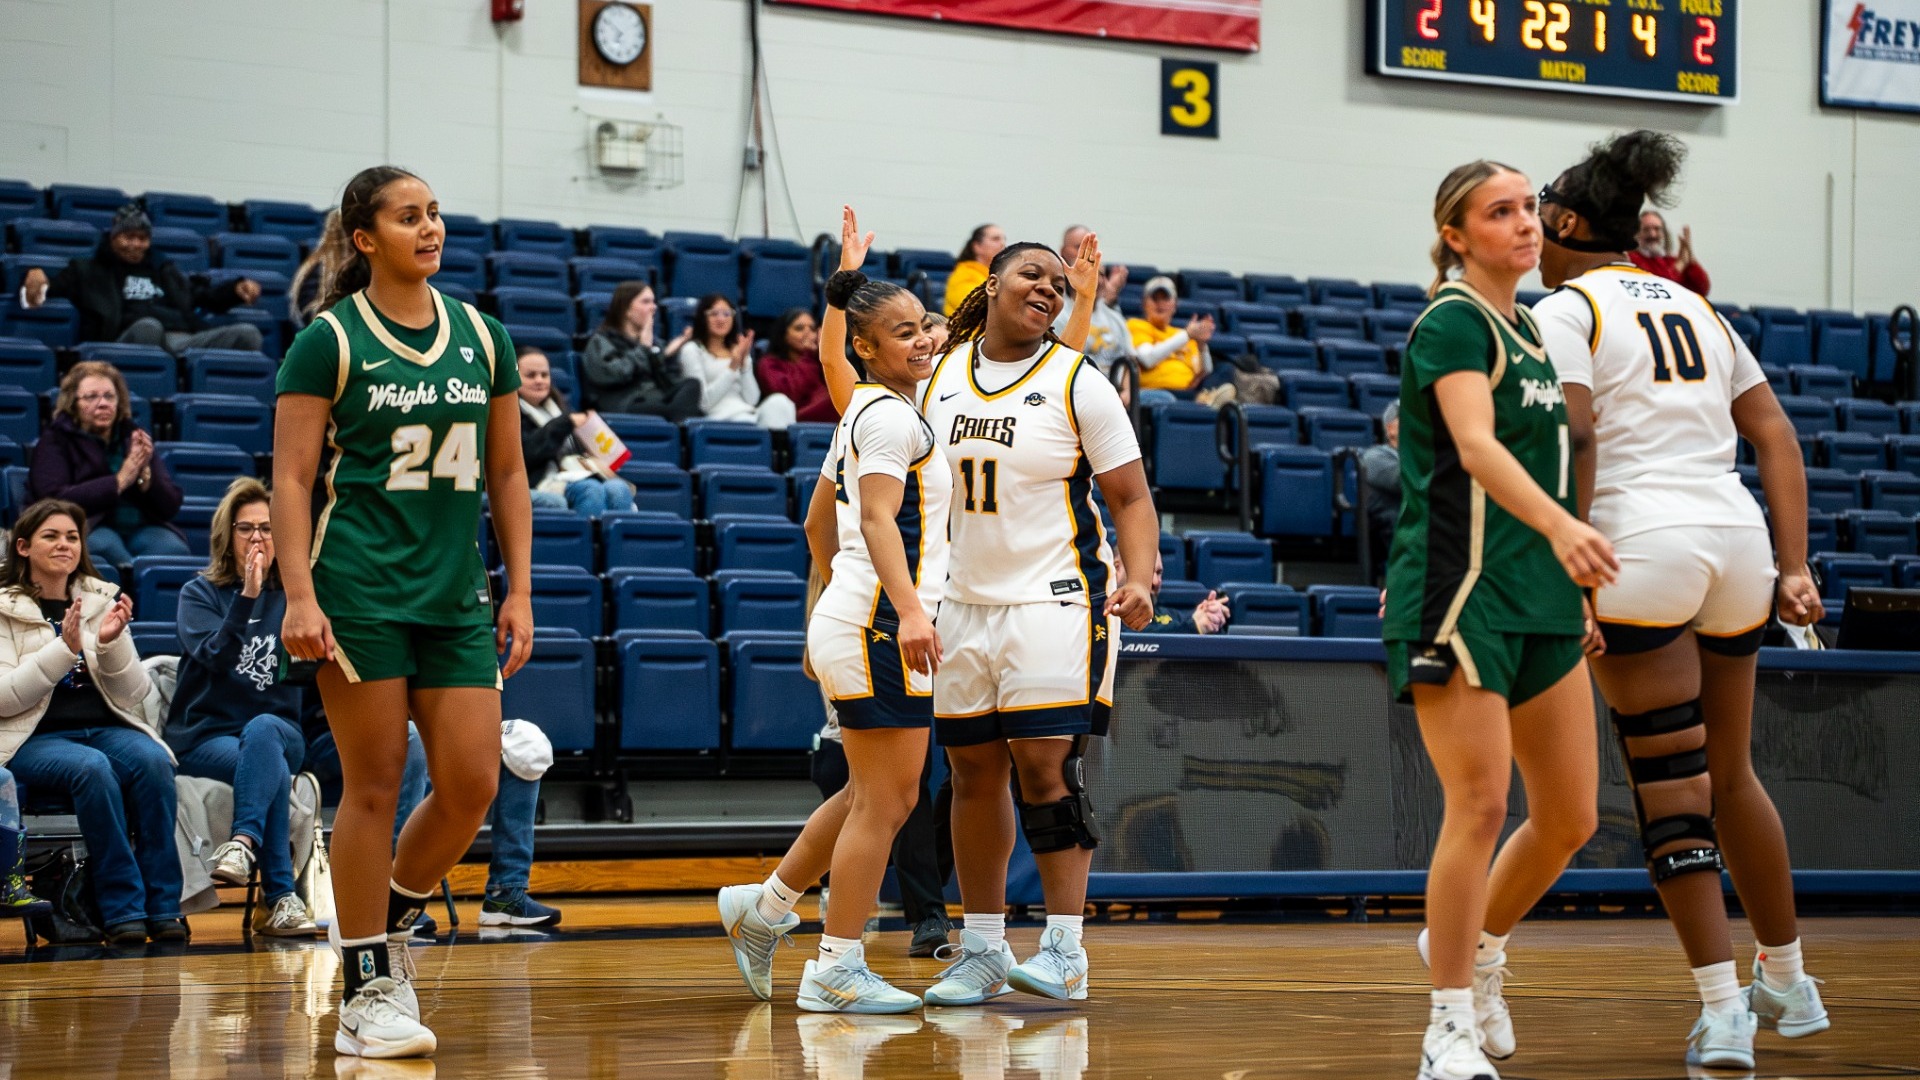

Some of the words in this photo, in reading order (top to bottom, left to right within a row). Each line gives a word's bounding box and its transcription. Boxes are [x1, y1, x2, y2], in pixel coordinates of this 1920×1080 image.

[1416, 0, 1443, 40] 2
[1470, 0, 1496, 42] 4
[1521, 0, 1570, 52] 22
[1594, 10, 1607, 53] 1
[1631, 13, 1657, 57] 4
[1692, 16, 1717, 65] 2
[1401, 46, 1447, 70] SCORE
[1540, 59, 1586, 83] MATCH
[1169, 68, 1212, 128] 3
[1677, 70, 1720, 95] SCORE
[1636, 311, 1707, 383] 10
[367, 380, 438, 414] Wright
[444, 377, 487, 405] State
[949, 414, 1017, 448] GRIFFS
[385, 422, 481, 491] 24
[958, 457, 999, 515] 11
[1122, 643, 1160, 652] ANC
